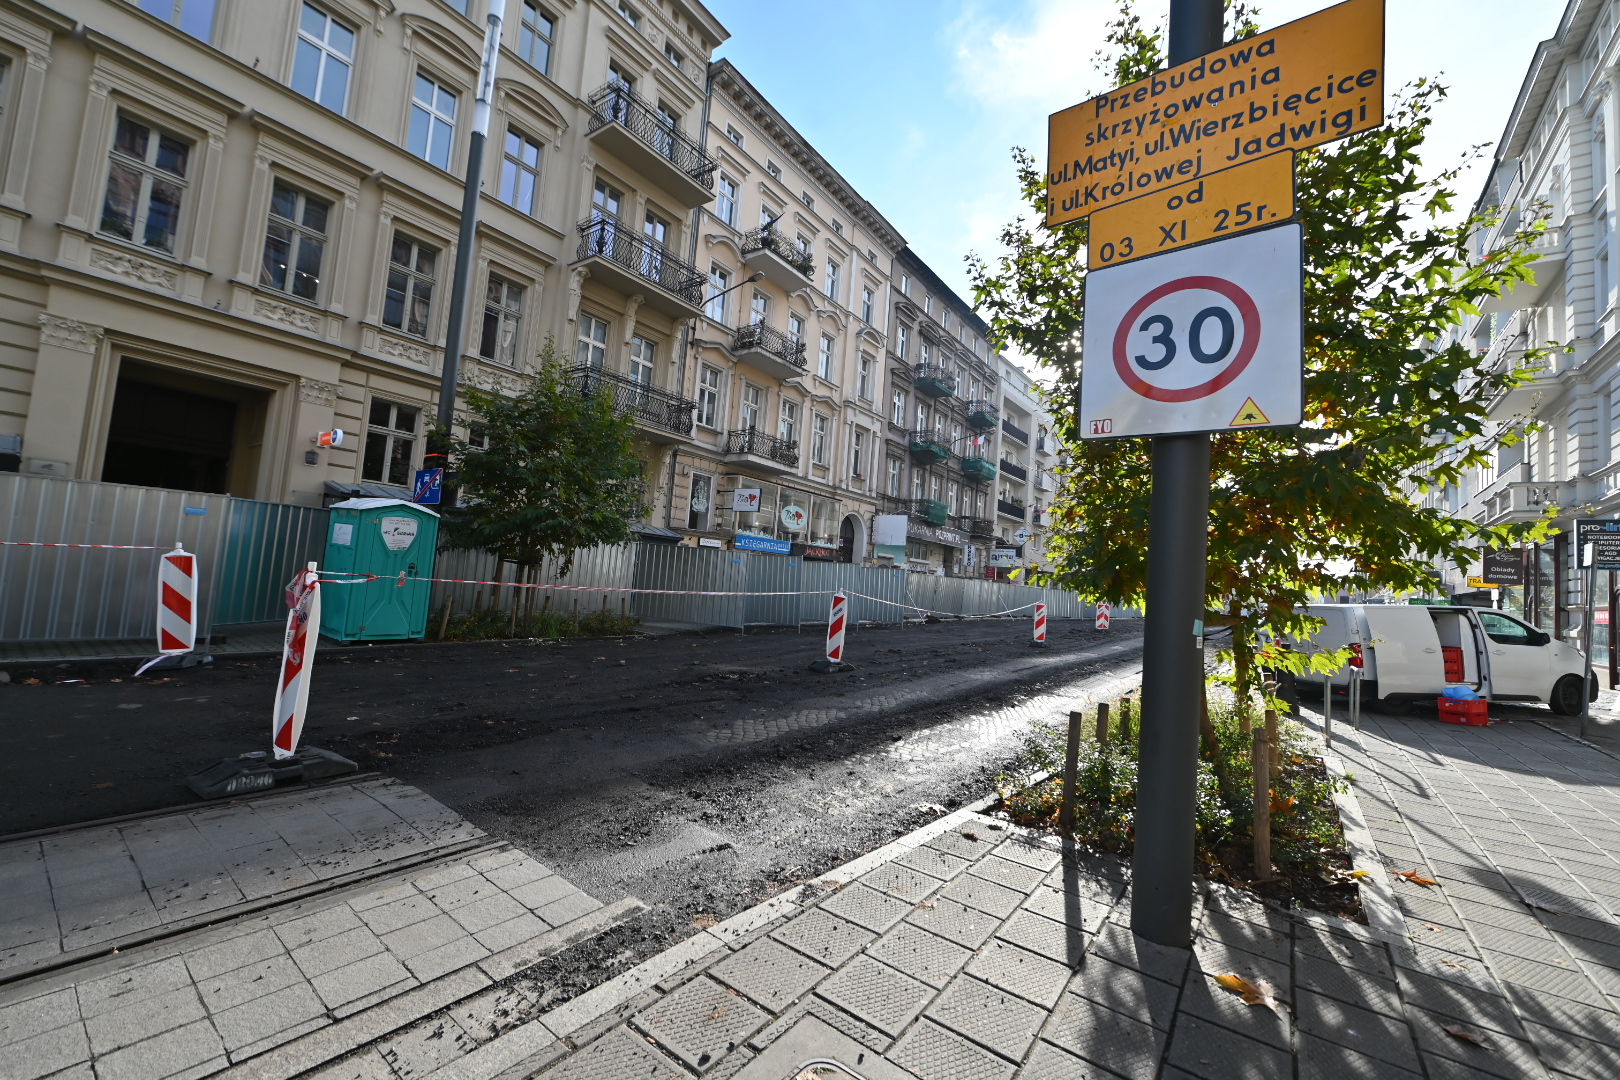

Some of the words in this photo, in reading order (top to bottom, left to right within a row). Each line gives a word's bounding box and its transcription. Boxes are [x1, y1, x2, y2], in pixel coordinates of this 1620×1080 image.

[1085, 66, 1281, 147] skrzyżowania
[1095, 38, 1276, 118] Przebudowa
[1049, 198, 1055, 216] i
[1061, 150, 1203, 213] ul.Królowej
[1226, 97, 1367, 162] Jadwigi
[1050, 141, 1141, 186] ul.Matyi,
[1144, 68, 1377, 157] ul.Wierzbięcice
[1100, 237, 1134, 263] 03
[1158, 219, 1187, 247] XI
[1213, 202, 1277, 233] 25r.
[1167, 181, 1204, 211] od
[1134, 306, 1235, 371] 30
